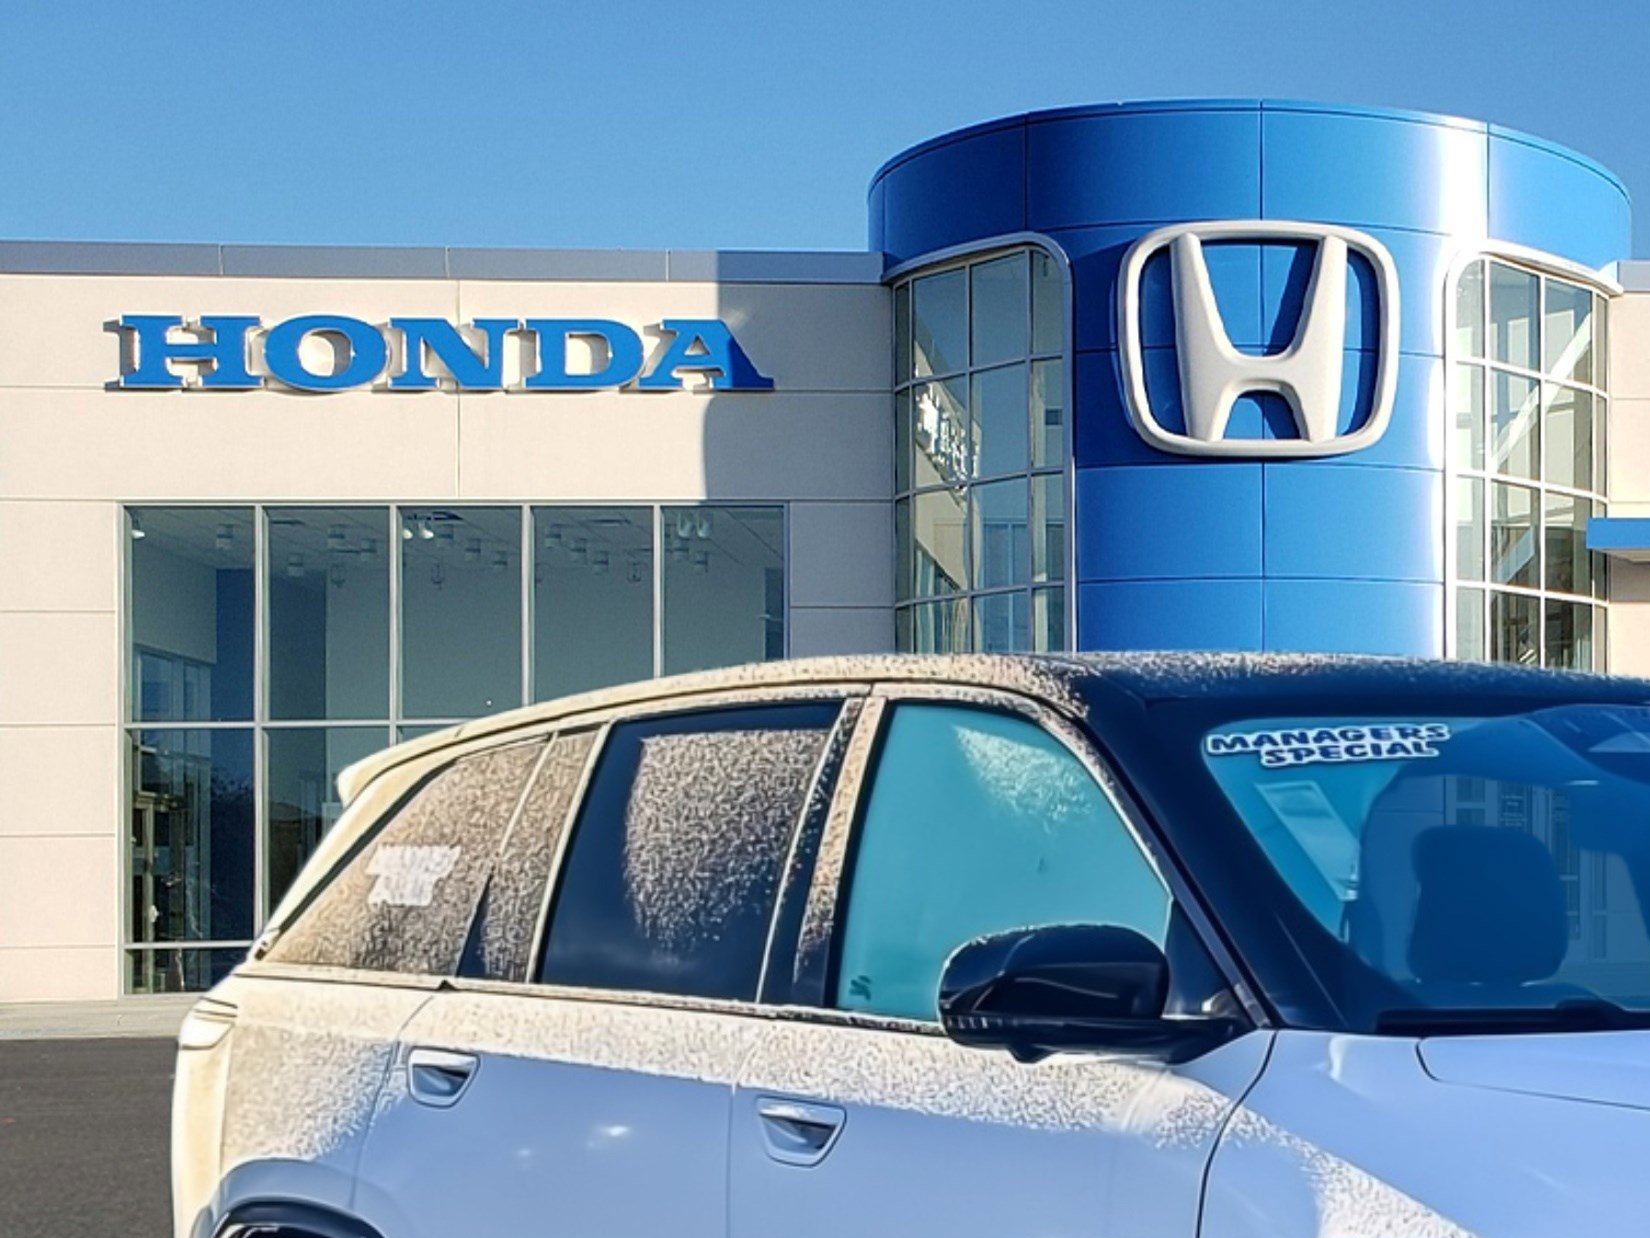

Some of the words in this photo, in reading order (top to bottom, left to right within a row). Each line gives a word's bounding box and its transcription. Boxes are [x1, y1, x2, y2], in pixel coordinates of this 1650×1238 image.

[118, 313, 775, 393] HONDA
[1209, 723, 1448, 753] MANAGERS
[1264, 741, 1437, 765] SPECIAL
